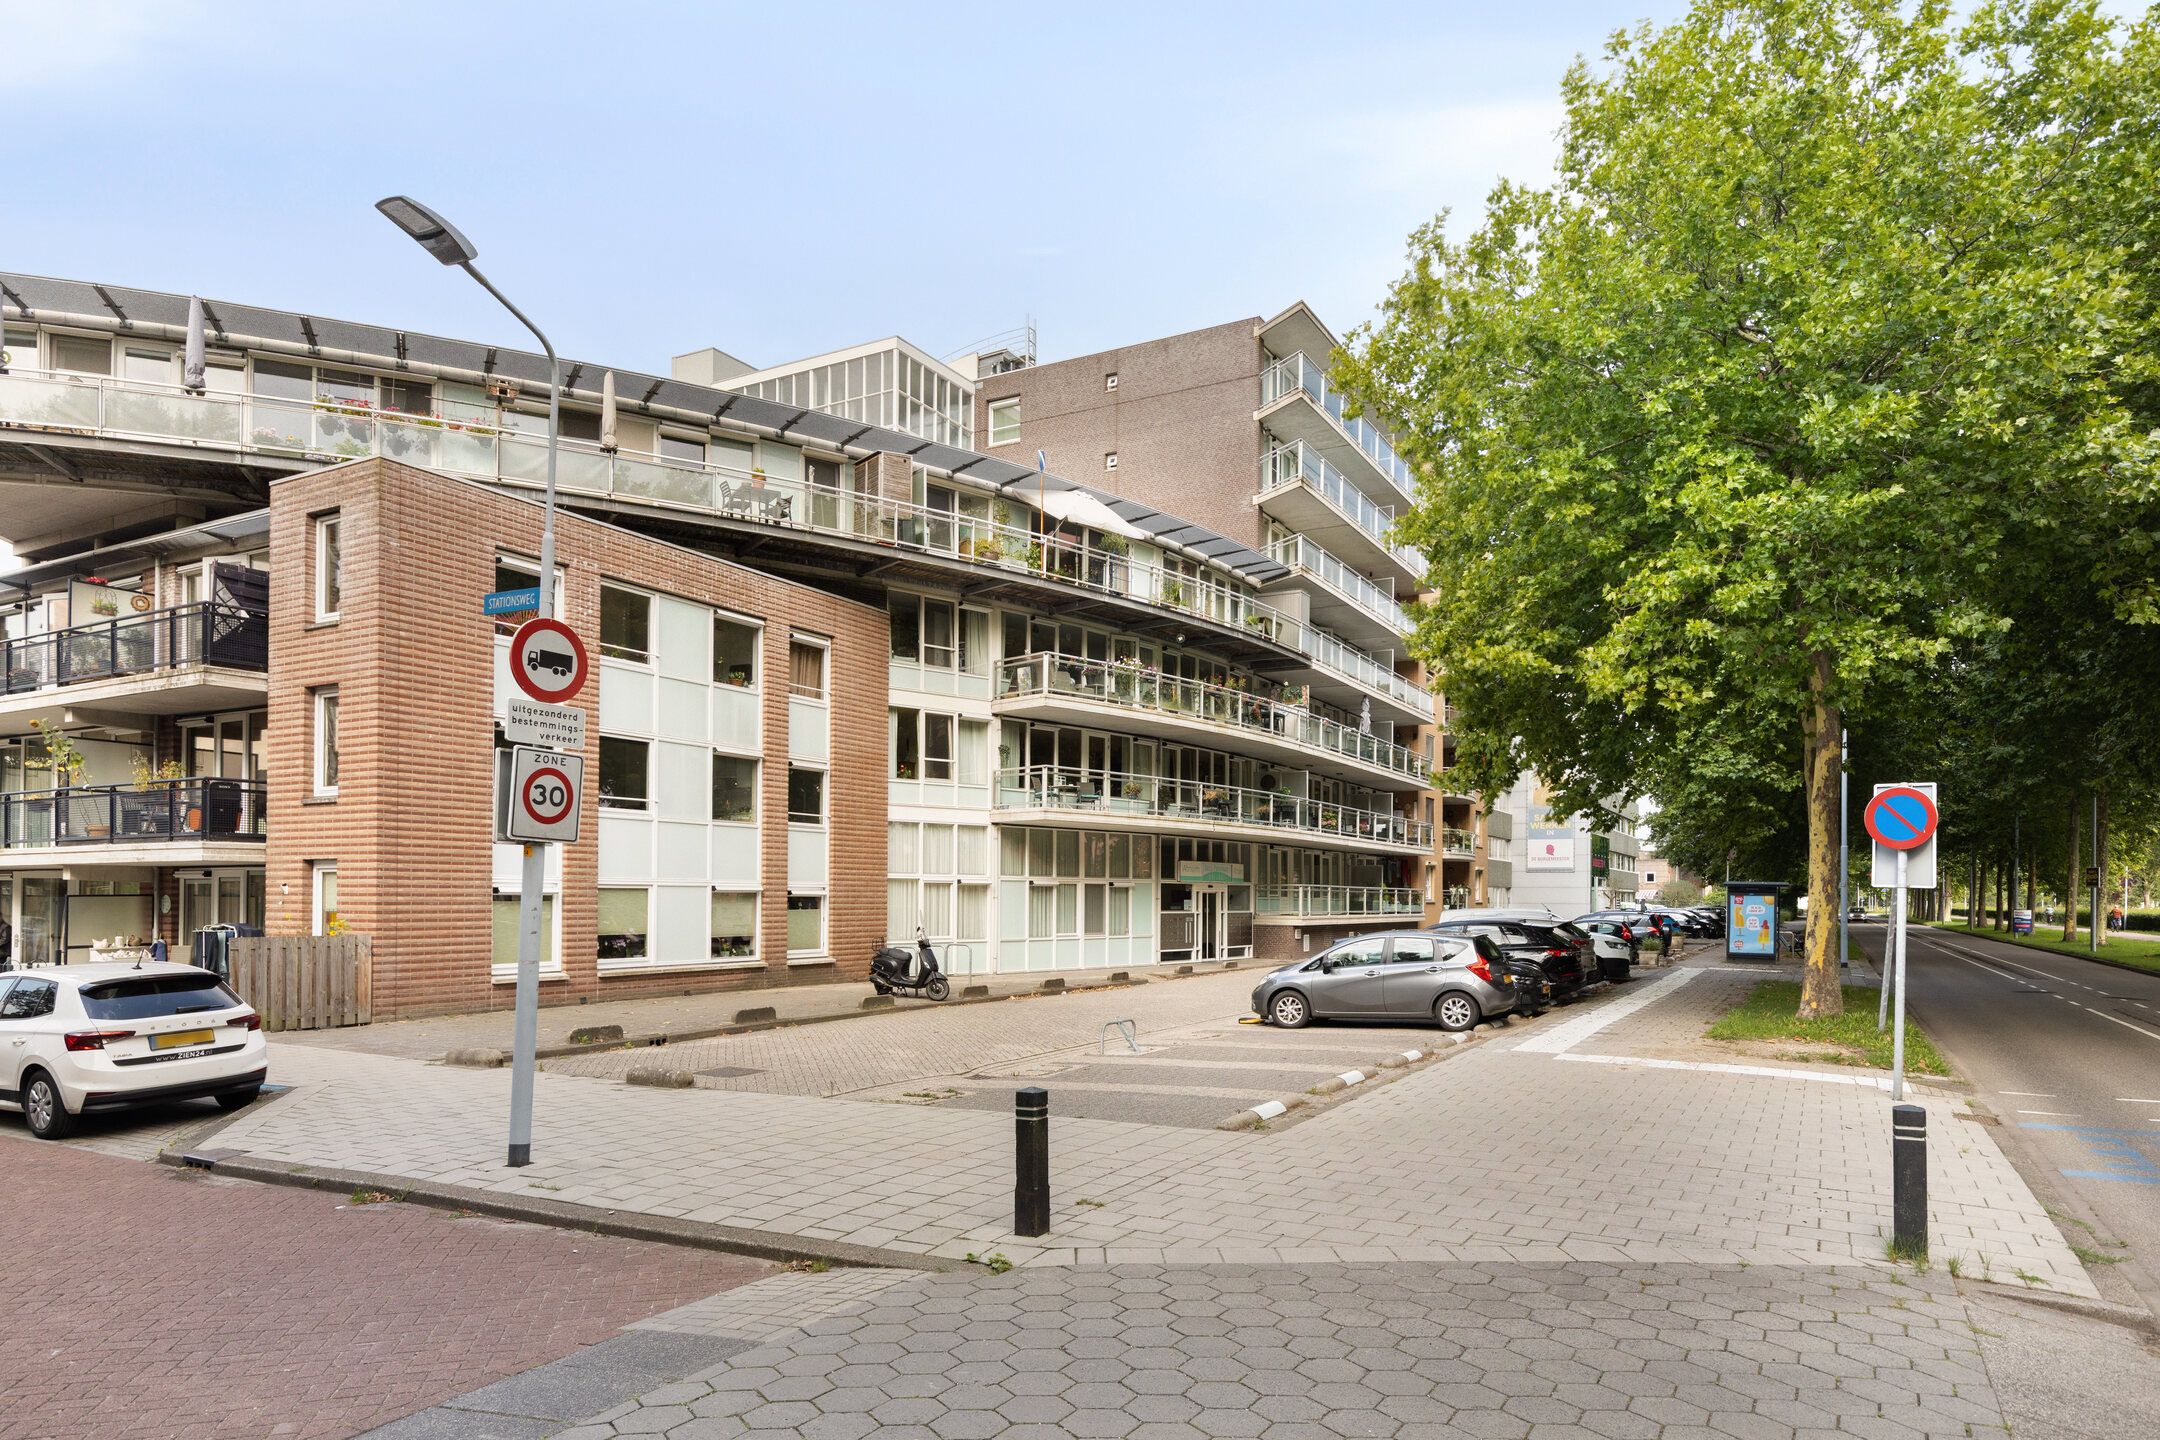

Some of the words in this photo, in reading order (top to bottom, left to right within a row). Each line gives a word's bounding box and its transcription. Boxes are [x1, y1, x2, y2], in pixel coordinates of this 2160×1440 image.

[488, 593, 535, 609] STATIONSWEG
[512, 705, 578, 721] uitgezonderd
[512, 716, 583, 734] bestemmings-
[539, 733, 578, 743] verkeer
[534, 754, 567, 766] ZONE
[532, 784, 565, 807] 30
[155, 1049, 213, 1062] www.ZIEN24.nl
